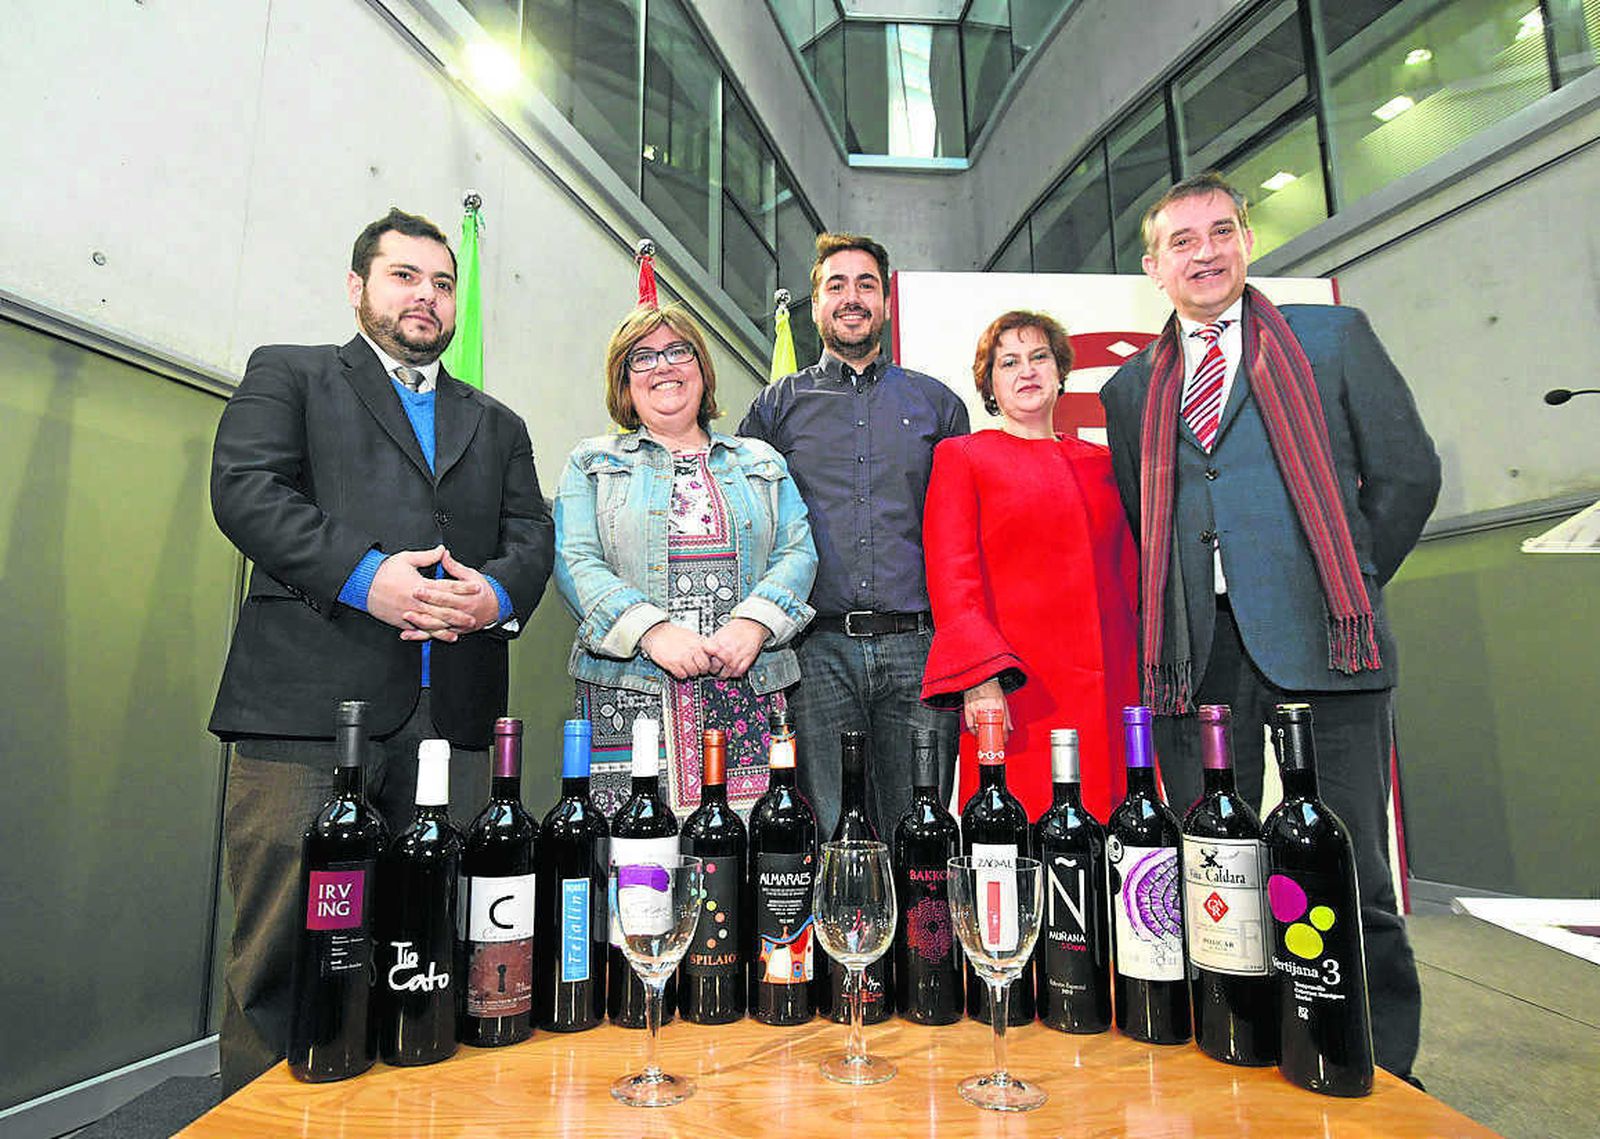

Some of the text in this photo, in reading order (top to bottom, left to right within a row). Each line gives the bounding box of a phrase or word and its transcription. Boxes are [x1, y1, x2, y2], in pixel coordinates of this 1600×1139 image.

[760, 872, 811, 886] ALMARAES
[1206, 869, 1246, 884] Caldara
[319, 883, 352, 899] IRV
[1048, 857, 1086, 933] Ñ
[317, 901, 350, 917] ING
[489, 895, 514, 929] C
[1272, 956, 1341, 985] Vertijana 3
